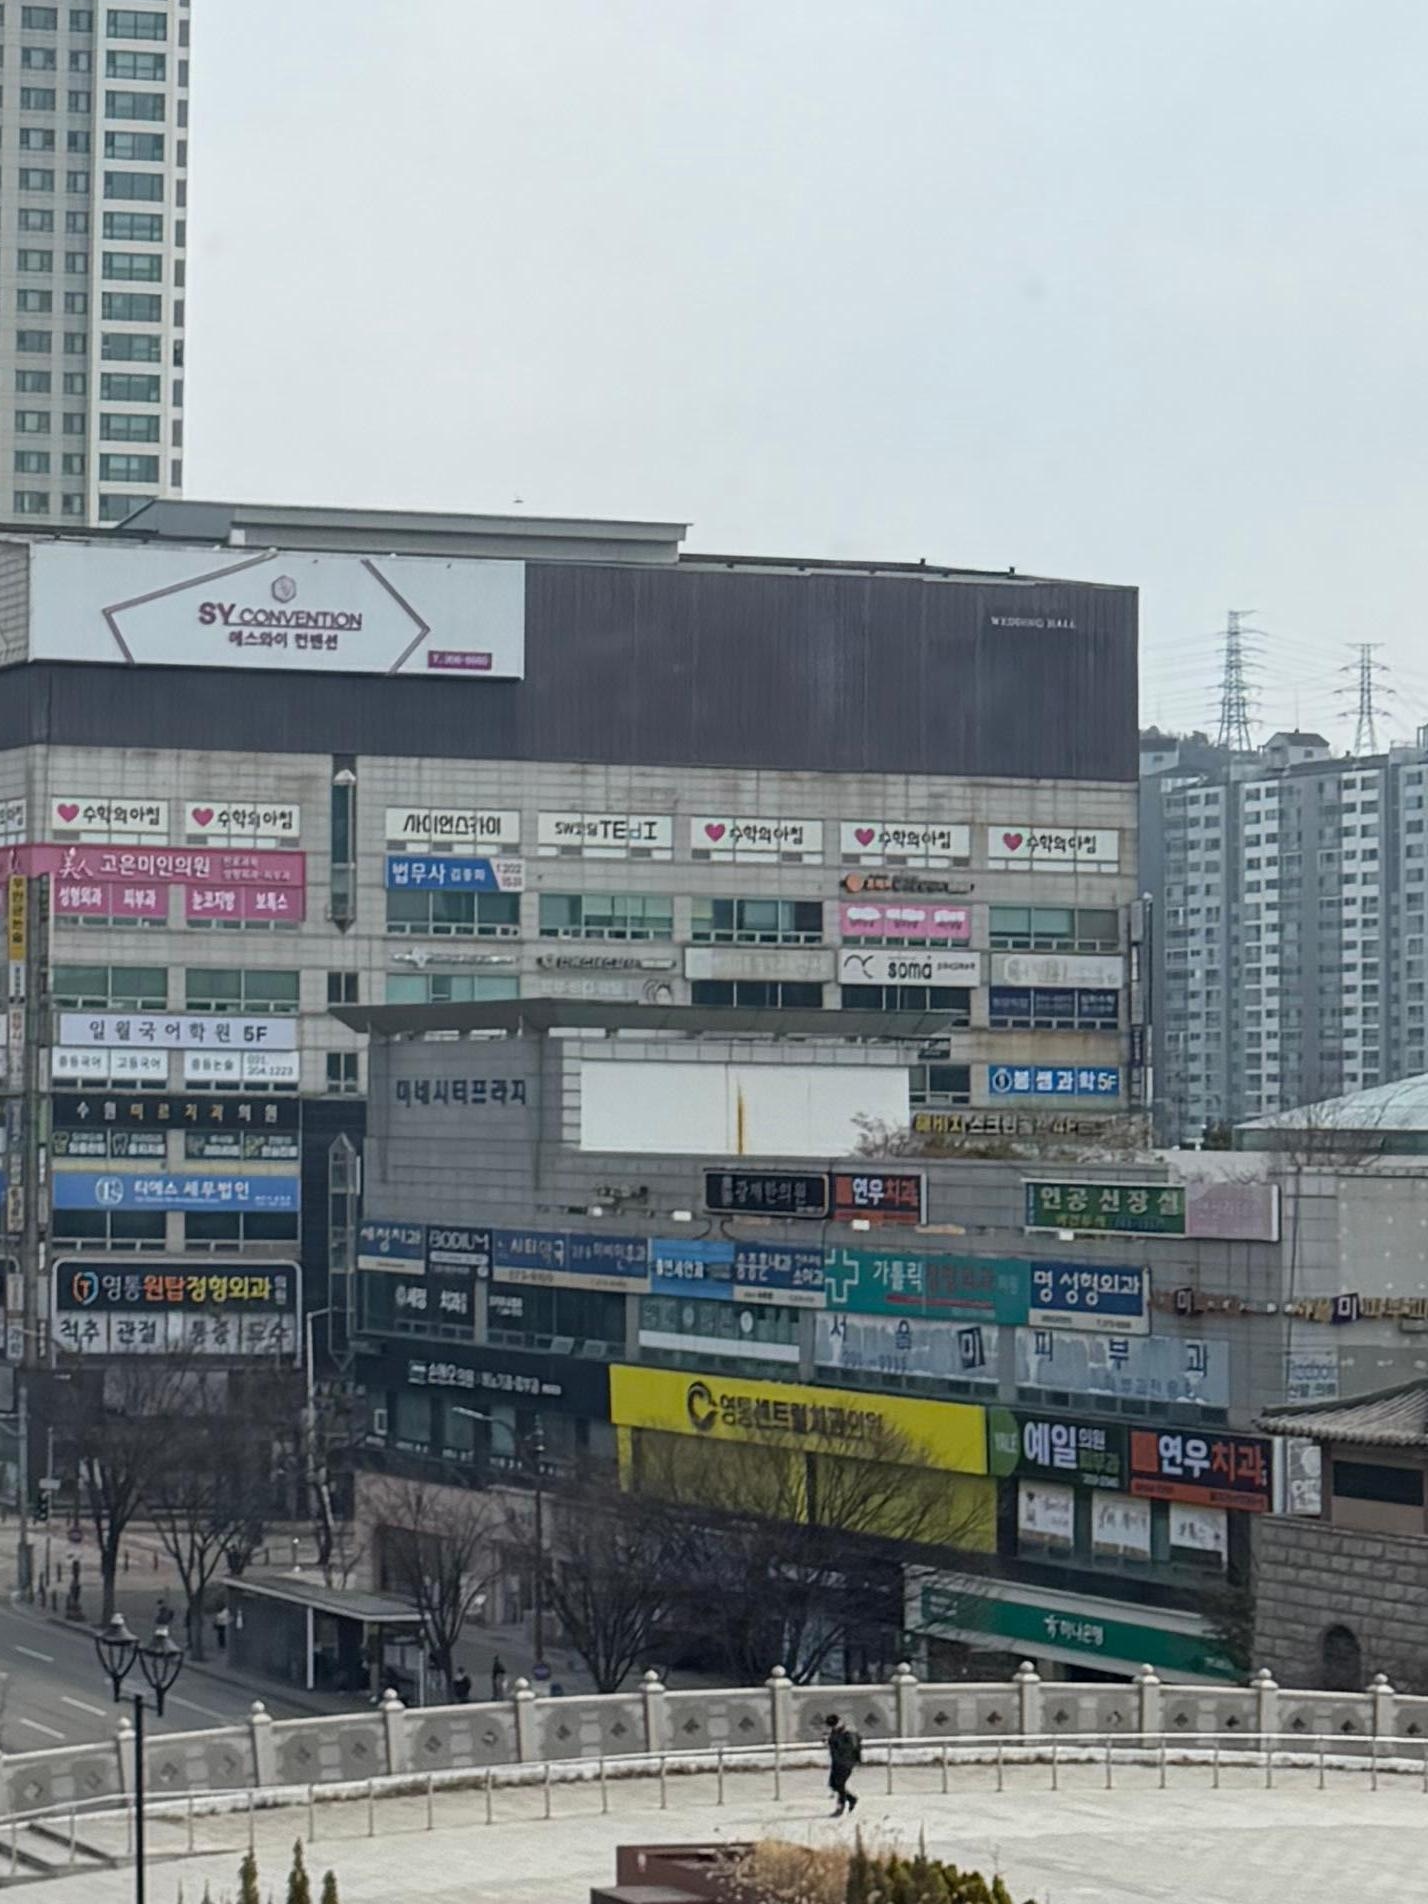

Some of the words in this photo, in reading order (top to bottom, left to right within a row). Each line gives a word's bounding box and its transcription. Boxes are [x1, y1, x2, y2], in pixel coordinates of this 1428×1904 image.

[198, 601, 237, 626] SY
[239, 607, 363, 630] CONVENTION
[228, 630, 288, 648] 에스와이
[294, 632, 338, 651] 컨벤션
[83, 804, 160, 826] 수학의아침
[217, 807, 293, 830] 수학의아침
[730, 824, 804, 845] 수학의아침
[878, 825, 951, 849] 수학의아침
[1026, 832, 1097, 854] 수학의아침
[101, 854, 210, 878] 고은미인의원
[392, 862, 446, 885] 법무사
[90, 1019, 231, 1042] 일월국어학원
[243, 1025, 268, 1043] 5F
[1097, 1072, 1118, 1090] 5F
[59, 1319, 100, 1342] 척추
[116, 1319, 157, 1344] 관절
[1023, 1422, 1077, 1470] 예일
[1079, 1427, 1106, 1451] 의원
[1159, 1434, 1265, 1486] 연우치과
